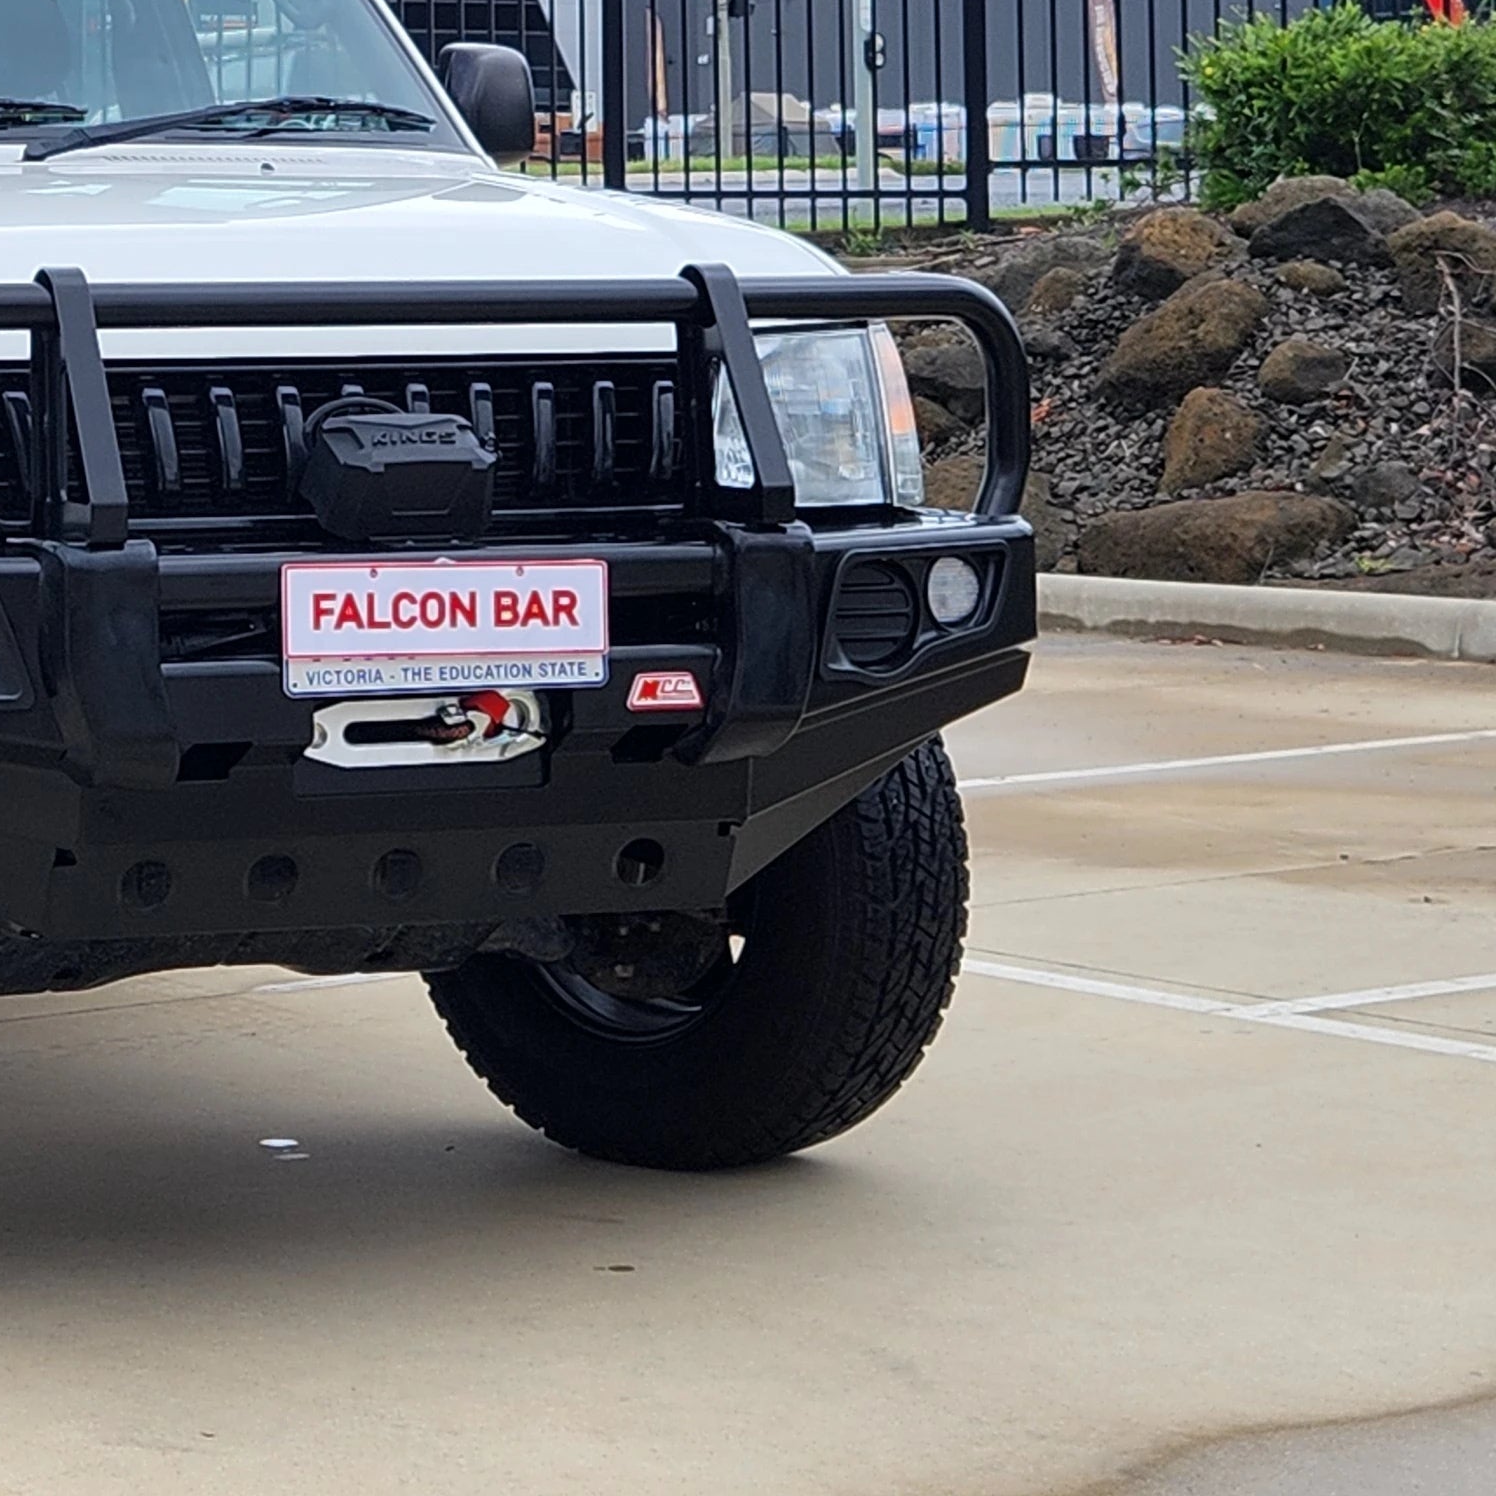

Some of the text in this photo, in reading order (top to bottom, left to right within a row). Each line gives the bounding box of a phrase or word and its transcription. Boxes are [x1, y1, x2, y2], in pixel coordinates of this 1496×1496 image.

[312, 590, 579, 630] FALCON BAR
[306, 669, 384, 686] VICTORIA
[401, 667, 433, 682] THE
[439, 663, 533, 680] EDUCATION
[537, 661, 587, 677] STATE
